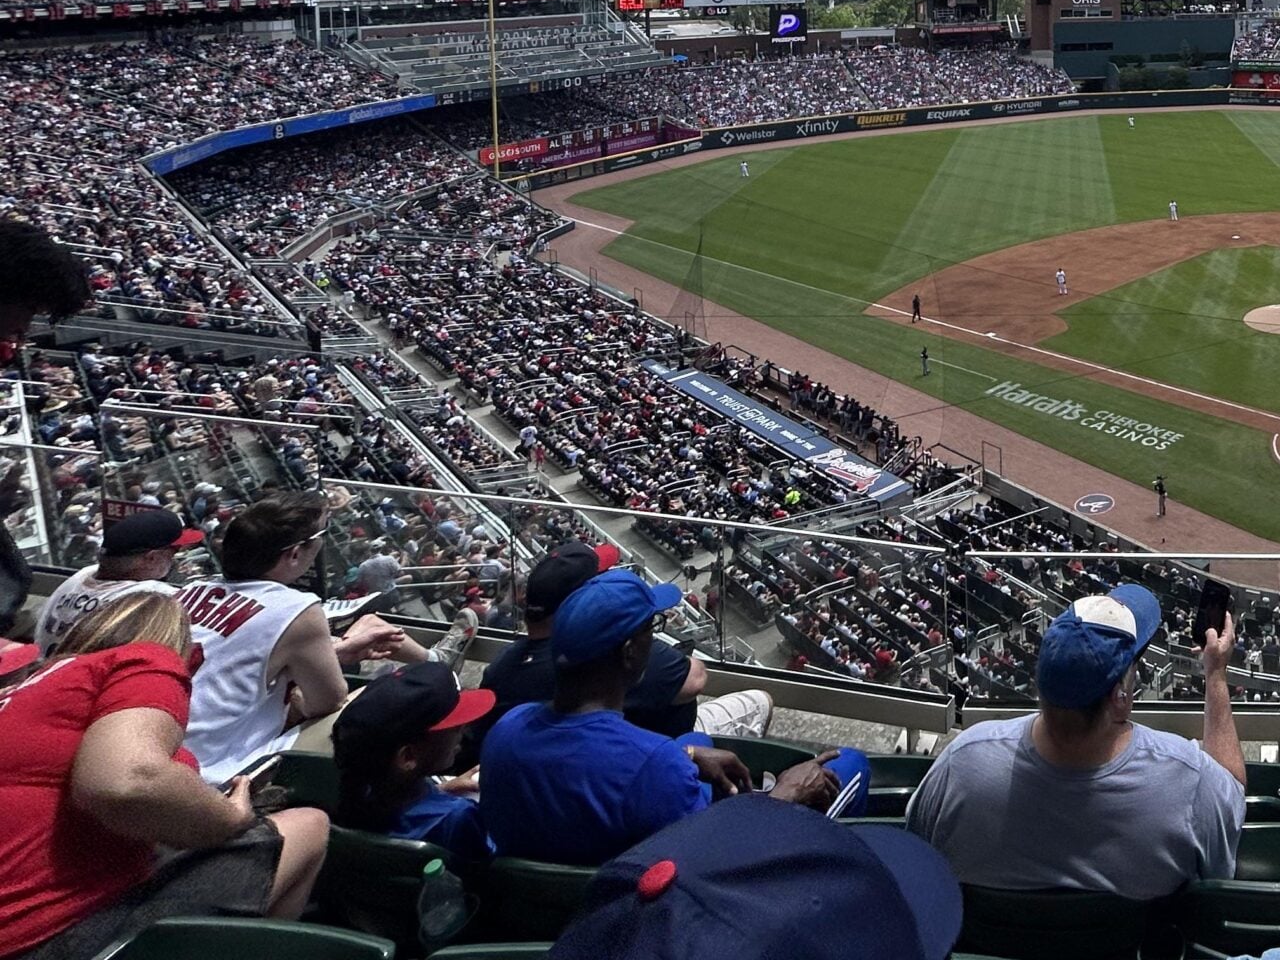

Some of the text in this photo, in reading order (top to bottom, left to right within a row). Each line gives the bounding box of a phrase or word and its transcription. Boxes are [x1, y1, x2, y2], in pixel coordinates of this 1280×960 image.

[716, 7, 728, 15] LG
[1006, 100, 1042, 110] HYUNDAI
[856, 111, 907, 126] QUIKRETE
[926, 107, 973, 120] EQUIFAX
[796, 118, 840, 136] xfinity
[735, 128, 777, 141] Wellstar
[514, 144, 541, 155] SOUTH
[549, 140, 560, 149] AL
[715, 394, 782, 432] TRUIST PARK
[1094, 409, 1185, 443] CHEROKEE
[1080, 417, 1172, 451] CASINOS
[107, 502, 122, 517] BE
